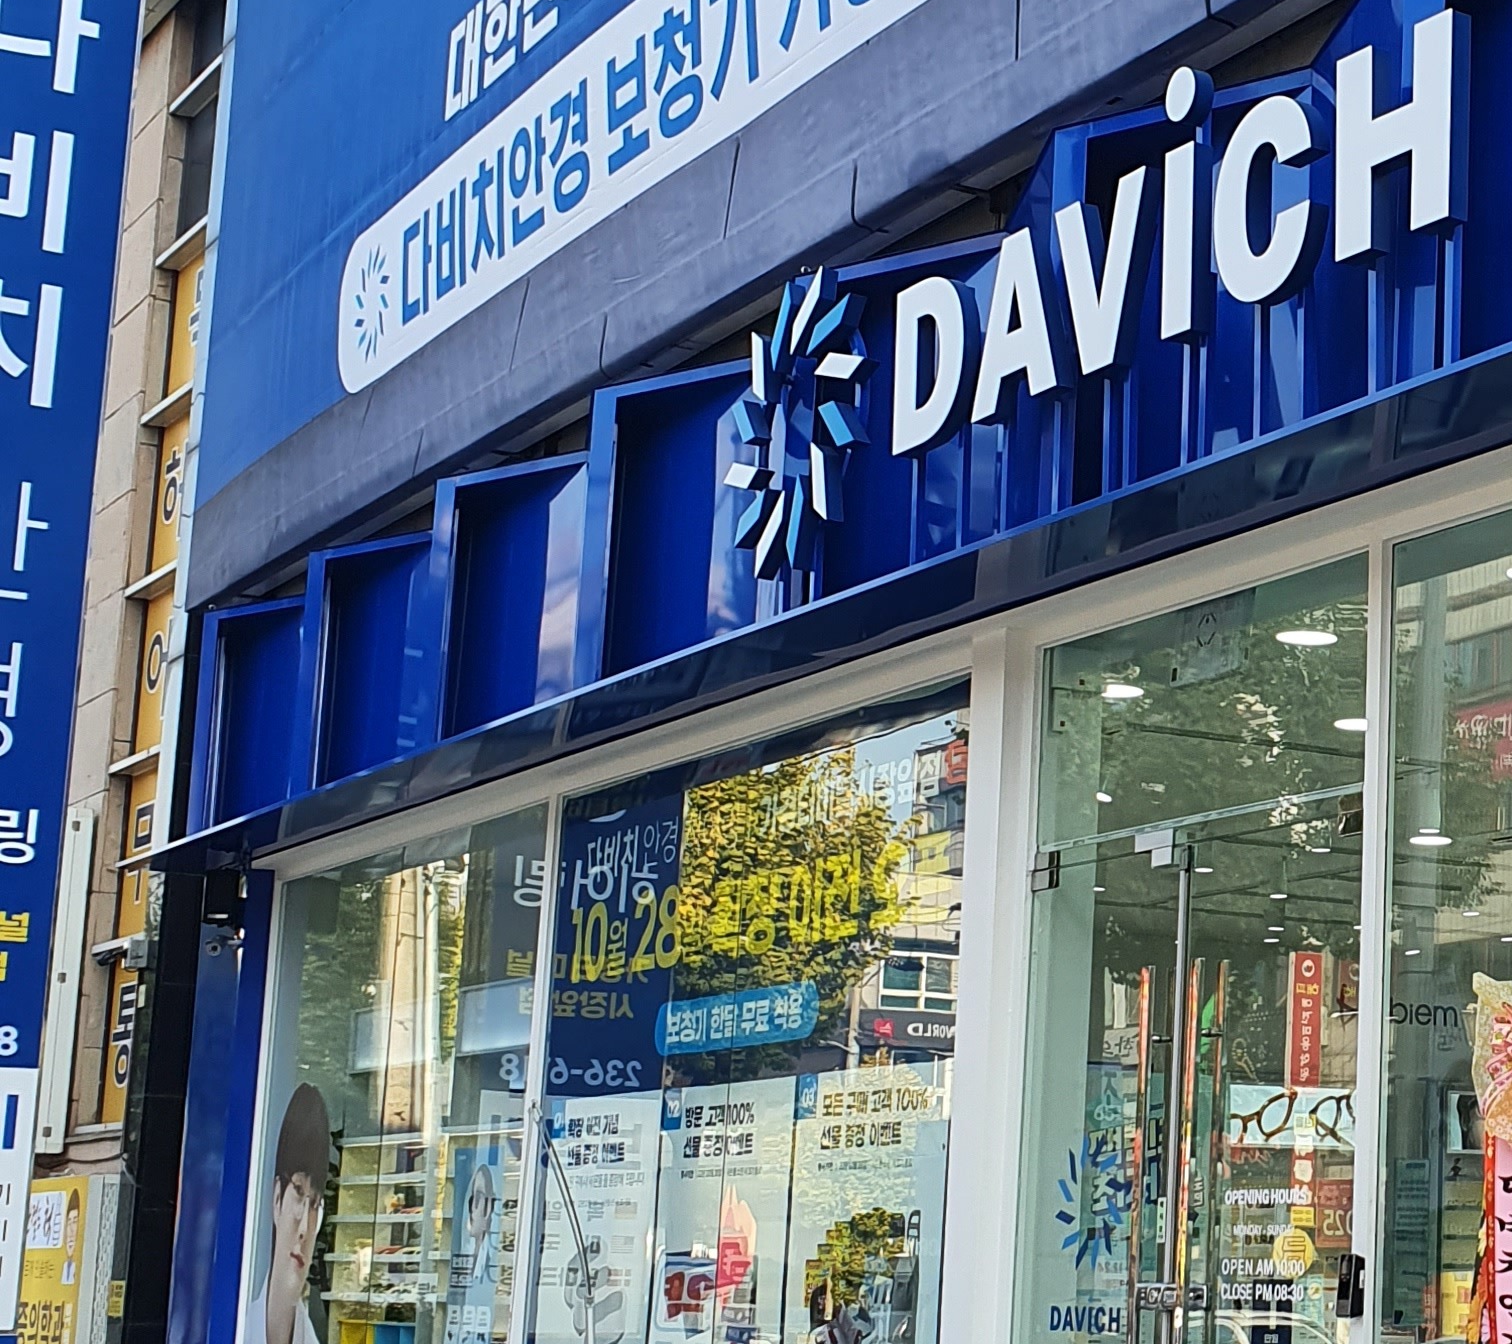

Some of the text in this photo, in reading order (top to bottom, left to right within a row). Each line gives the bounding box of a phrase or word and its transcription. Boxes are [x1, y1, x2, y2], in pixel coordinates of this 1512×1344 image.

[401, 77, 591, 325] 다비치안경
[1224, 1188, 1269, 1205] OPENING
[1221, 1258, 1253, 1276] OPEN
[1255, 1258, 1274, 1276] AM
[1220, 1283, 1305, 1302] CLOSE PM 08:30
